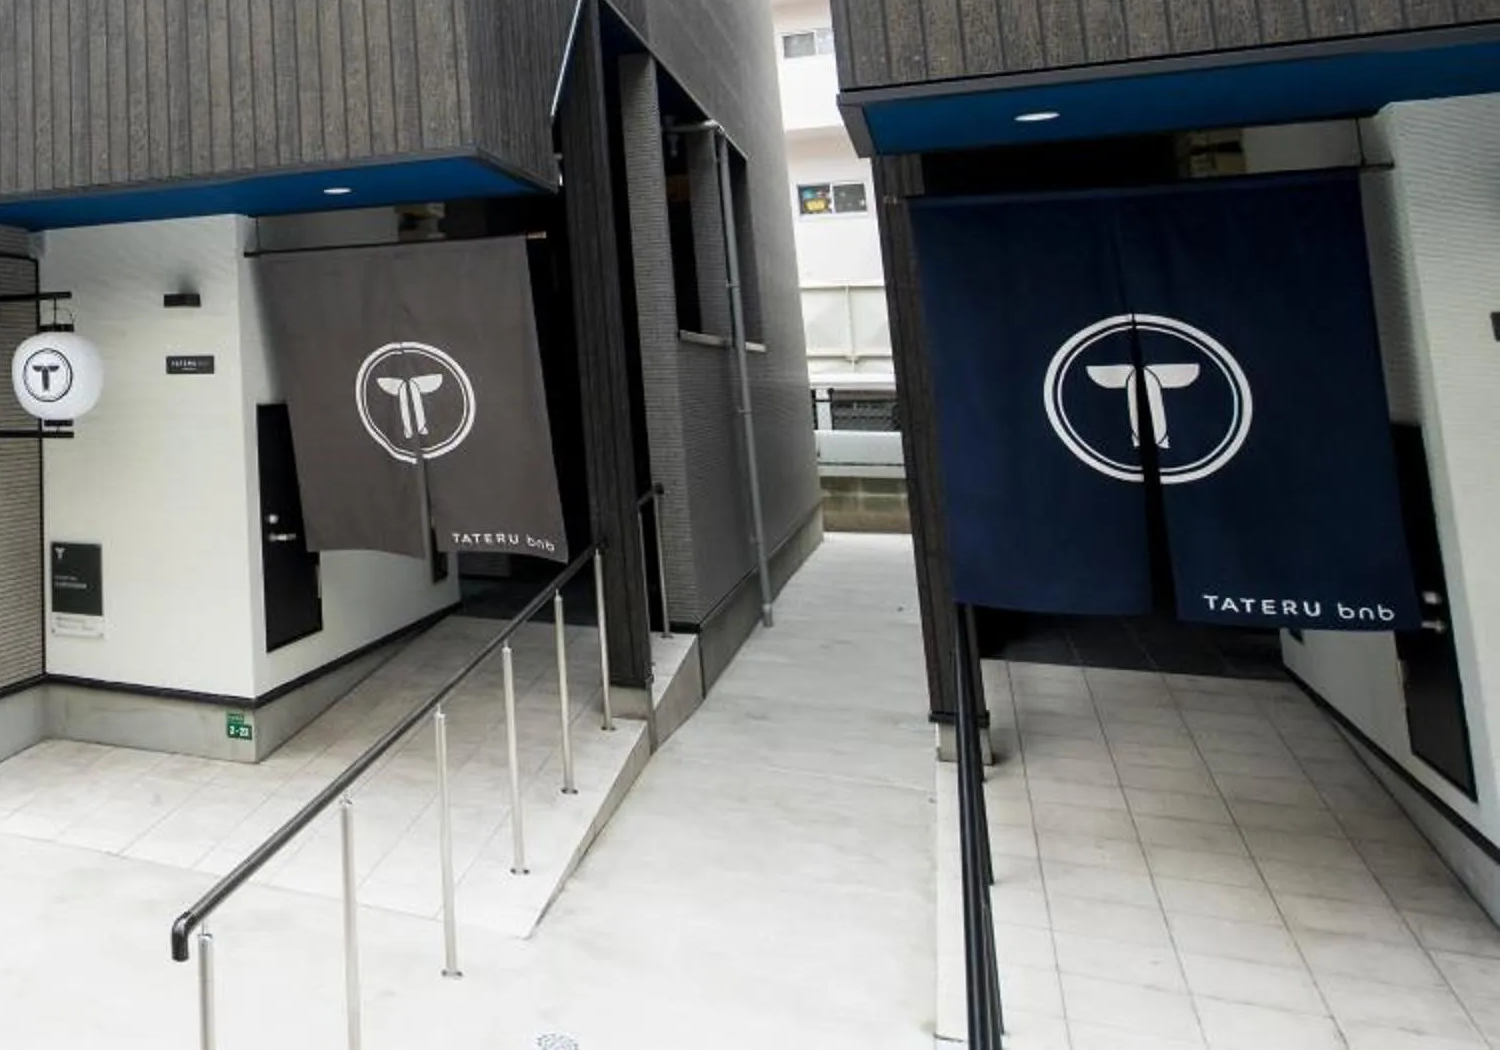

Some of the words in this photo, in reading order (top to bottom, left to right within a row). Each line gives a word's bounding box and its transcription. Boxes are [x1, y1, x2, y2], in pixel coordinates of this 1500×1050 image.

[451, 532, 519, 545] TATERU
[1203, 594, 1322, 617] TATERU
[1337, 602, 1395, 621] bnb
